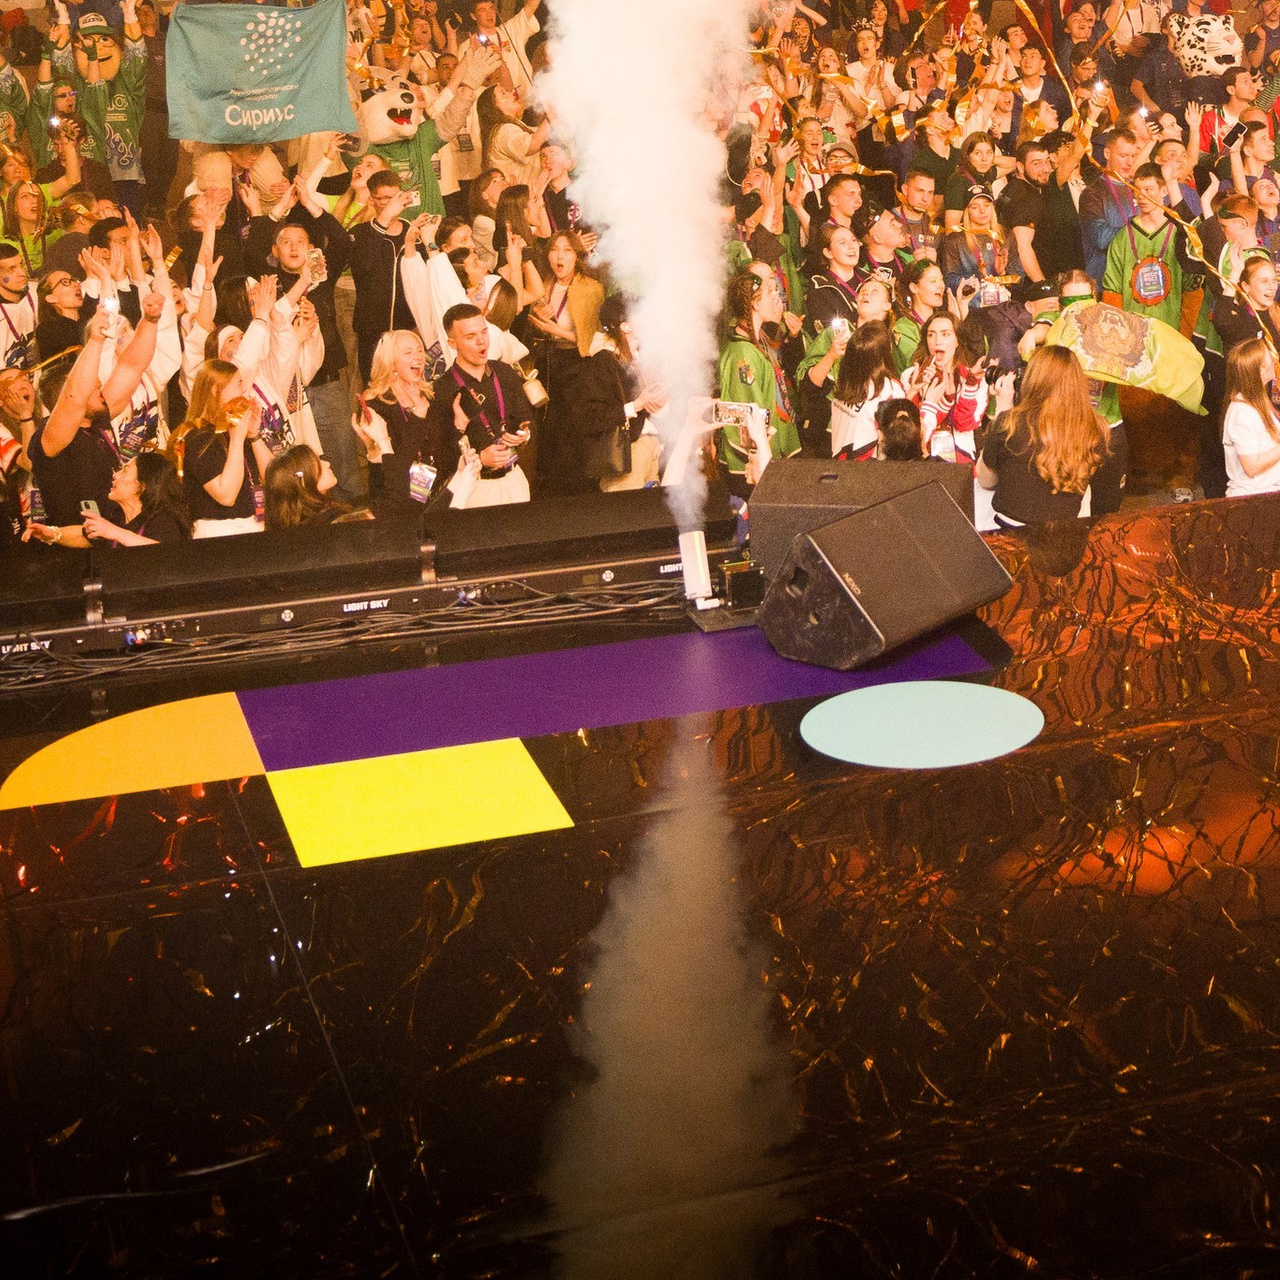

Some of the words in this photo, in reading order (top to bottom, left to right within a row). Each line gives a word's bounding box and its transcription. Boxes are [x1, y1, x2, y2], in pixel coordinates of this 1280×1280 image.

[224, 104, 295, 131] Сириус
[343, 601, 369, 613] LIGHT
[370, 598, 391, 610] SKY
